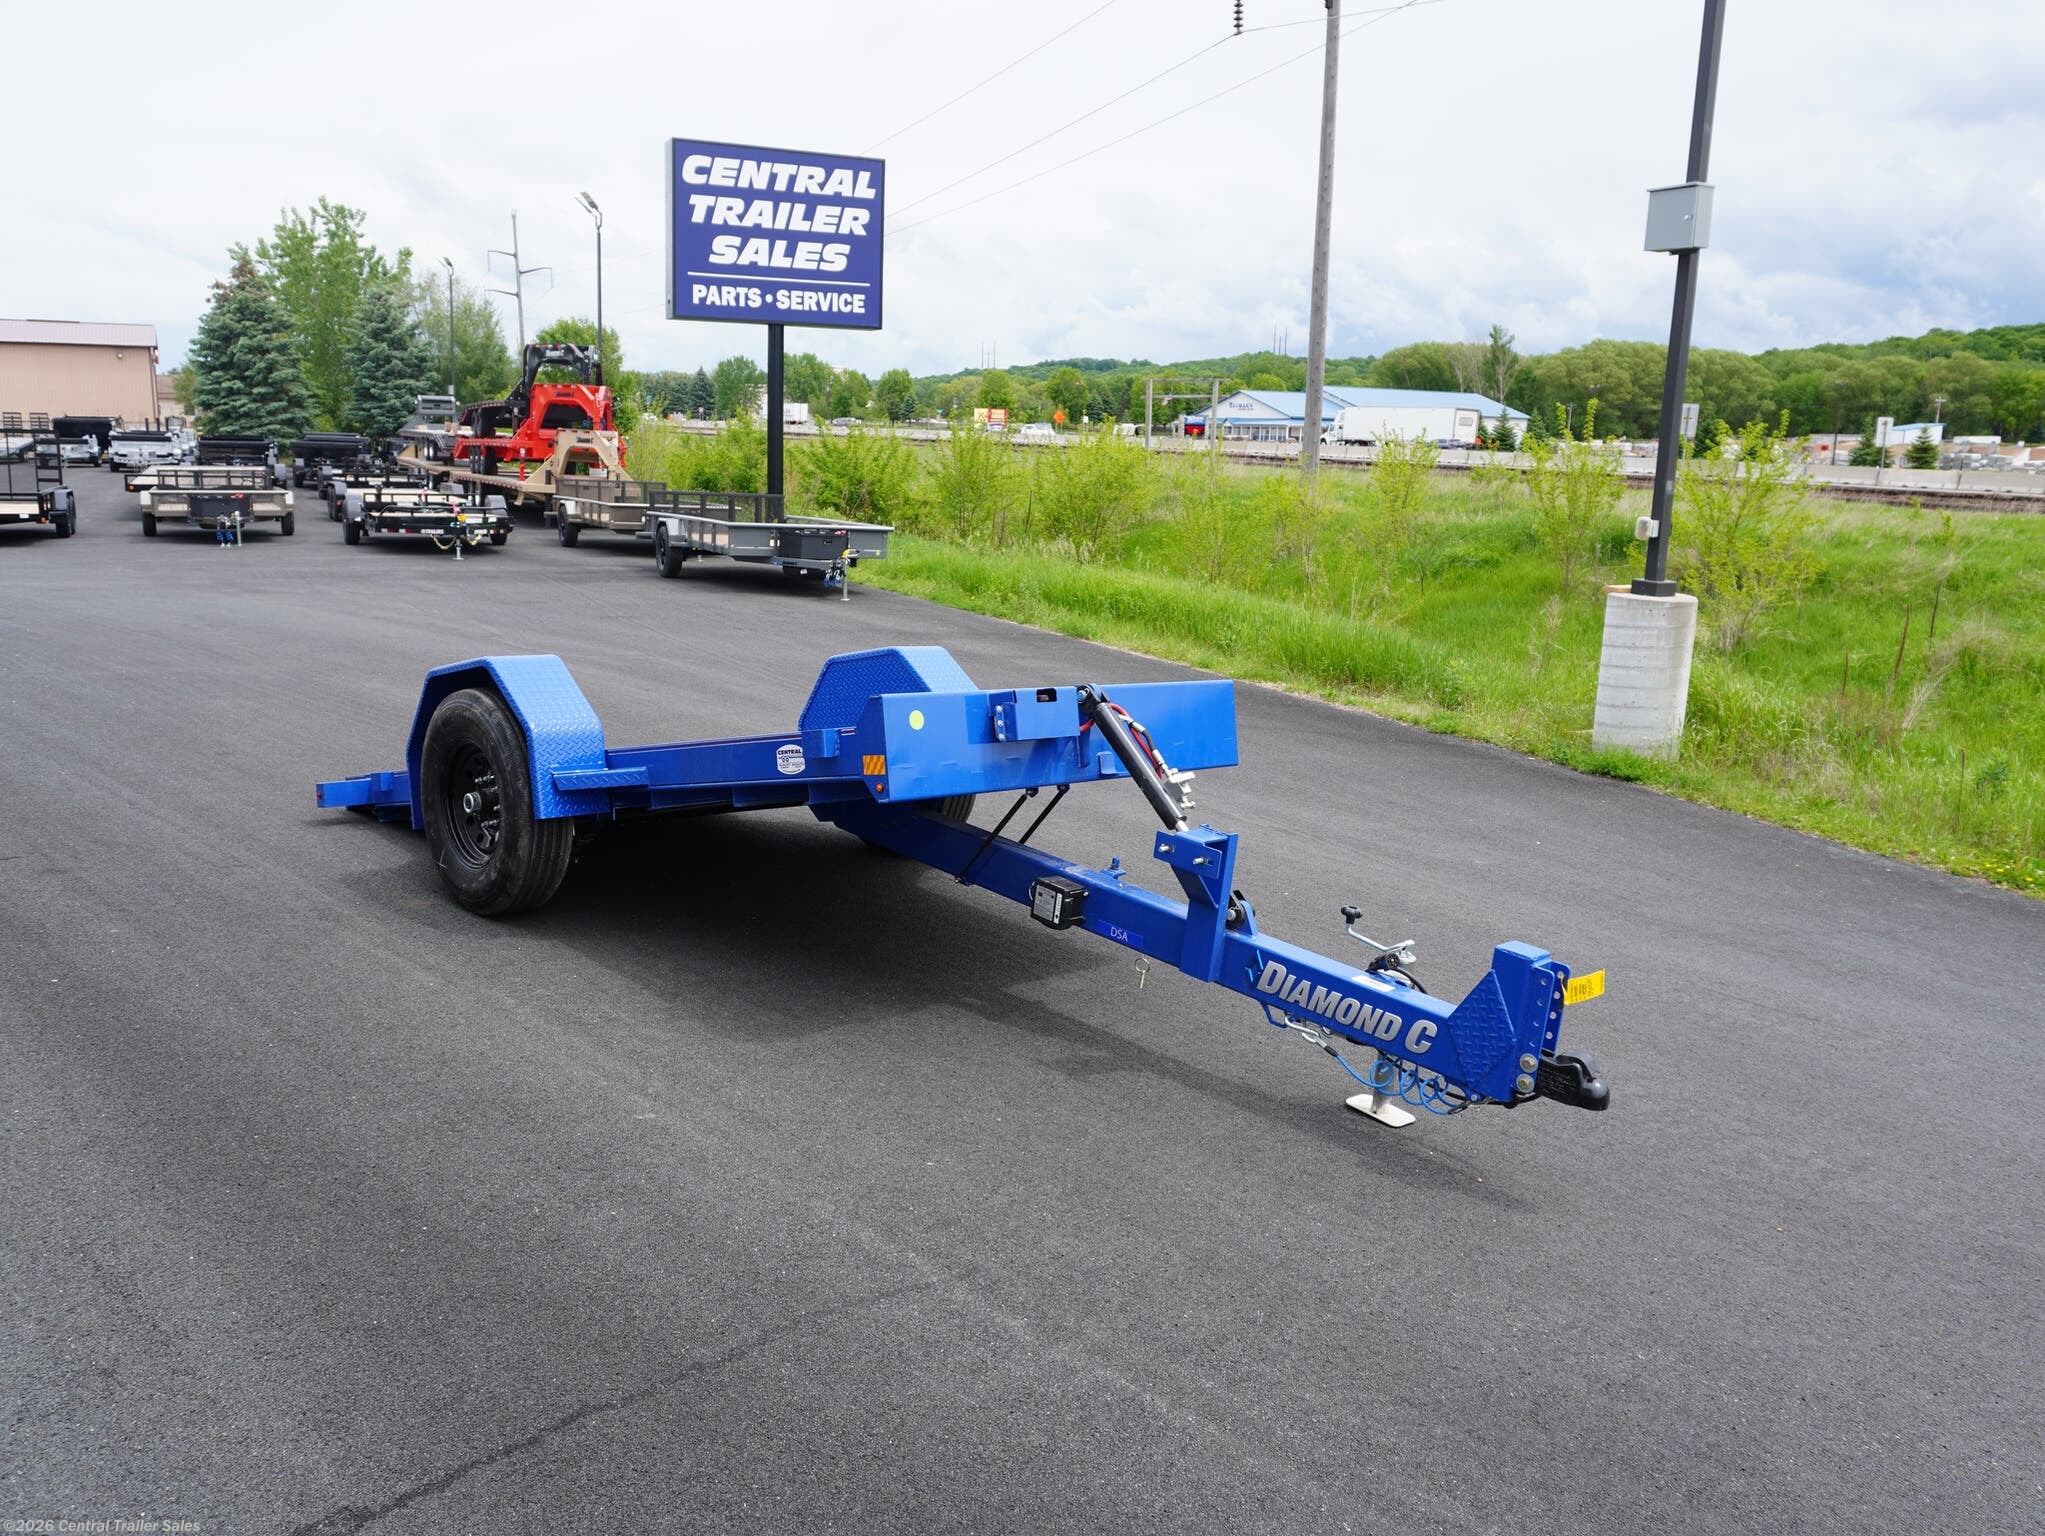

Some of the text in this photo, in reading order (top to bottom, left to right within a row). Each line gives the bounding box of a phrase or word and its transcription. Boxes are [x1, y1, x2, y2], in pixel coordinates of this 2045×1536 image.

[681, 154, 877, 199] CENTRAL
[689, 194, 871, 236] TRAILER
[708, 235, 851, 272] SALES
[692, 284, 866, 313] PARTS SERVICE
[1110, 926, 1129, 942] DSA
[1256, 960, 1438, 1054] DIAMOND C
